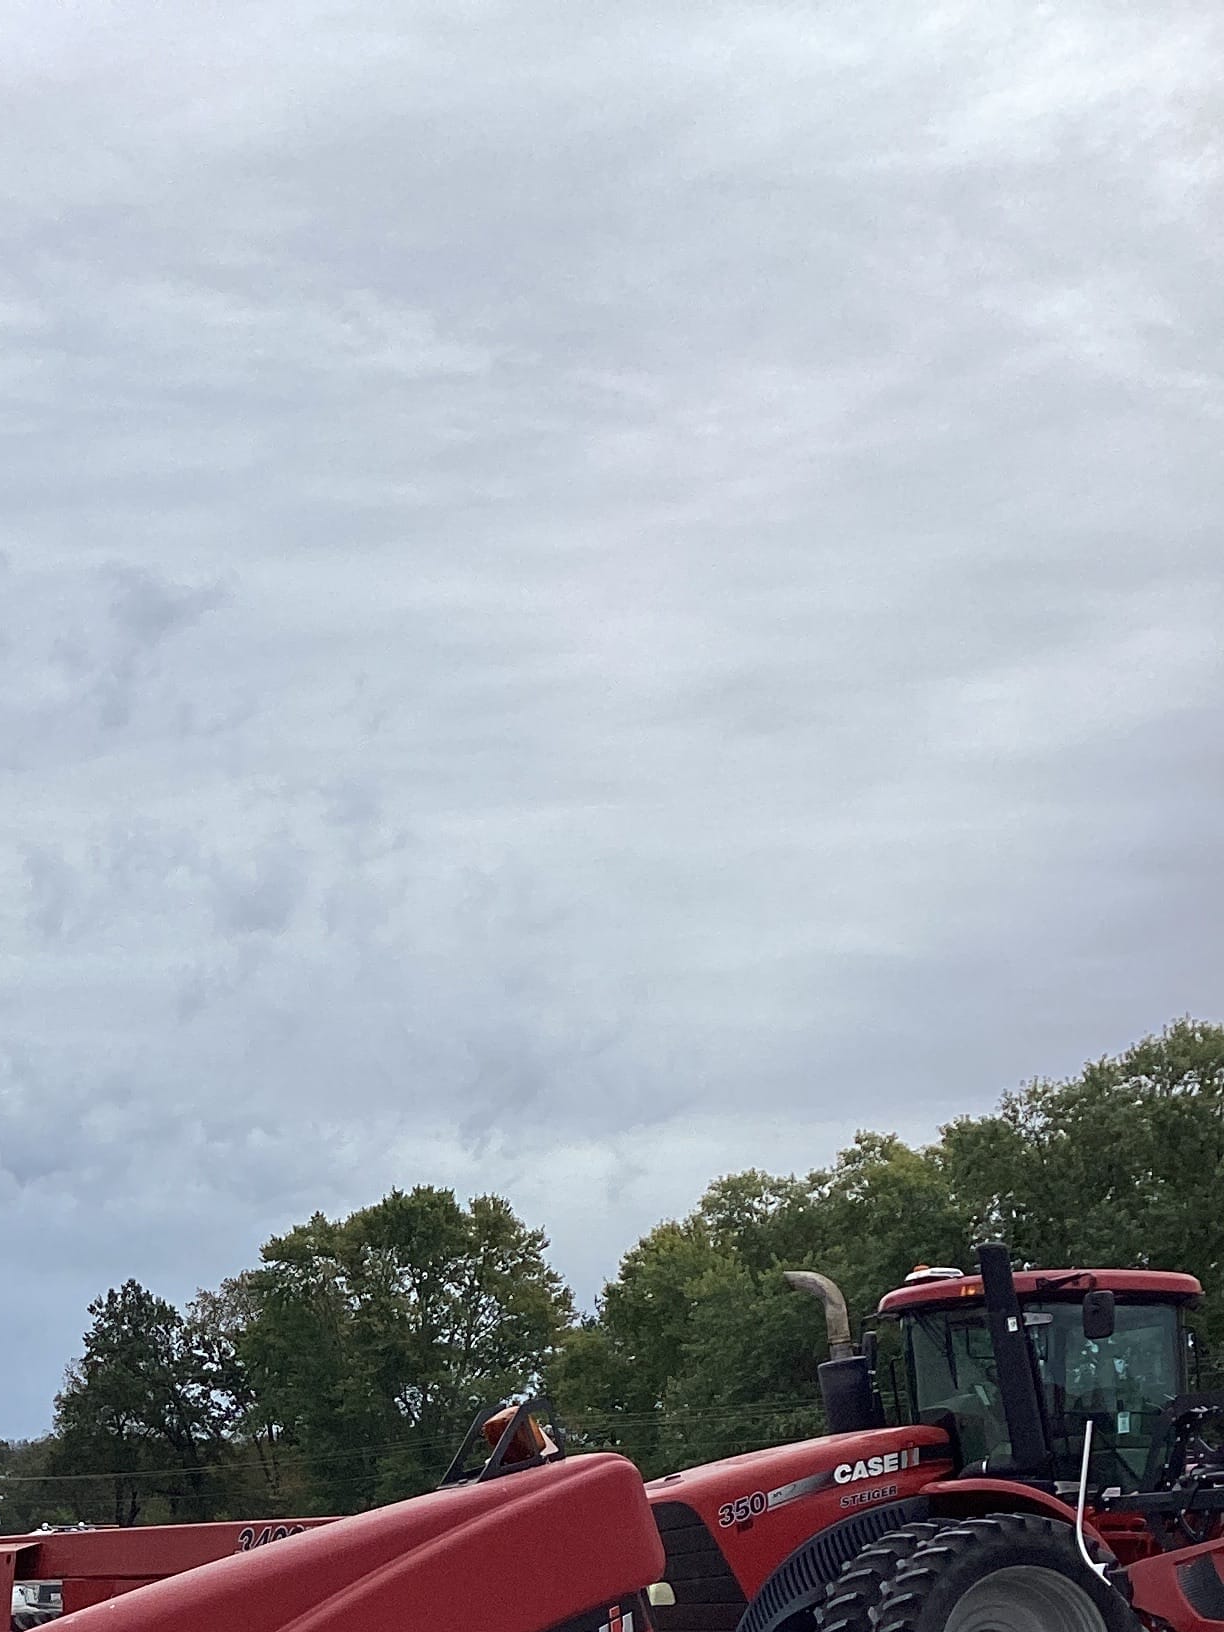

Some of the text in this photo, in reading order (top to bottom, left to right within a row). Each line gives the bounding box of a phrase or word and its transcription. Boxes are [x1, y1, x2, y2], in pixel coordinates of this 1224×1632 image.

[834, 1452, 899, 1484] CASE
[718, 1491, 767, 1527] 350
[839, 1485, 898, 1509] STEIGER
